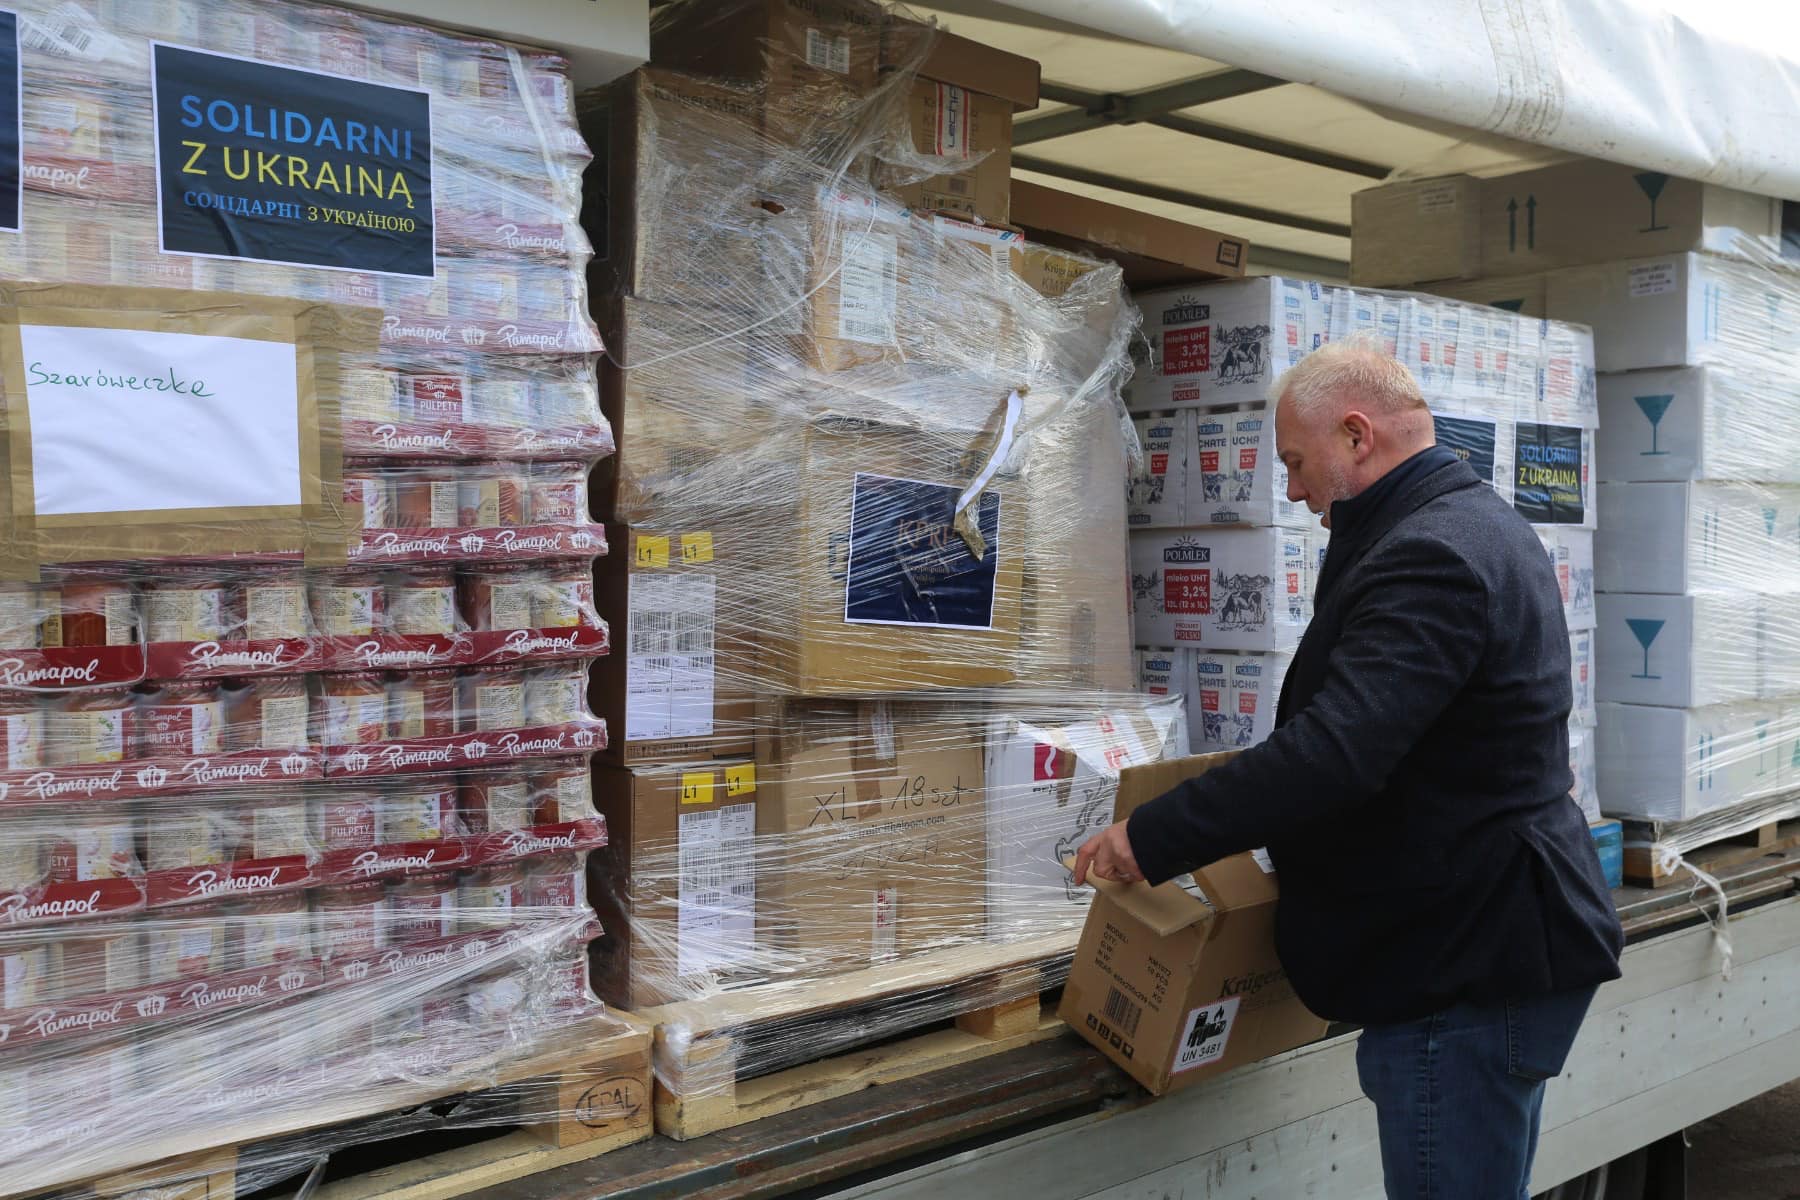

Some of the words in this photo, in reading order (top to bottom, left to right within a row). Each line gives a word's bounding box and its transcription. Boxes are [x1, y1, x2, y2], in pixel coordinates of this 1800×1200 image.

[180, 94, 412, 161] SOLIDARNI
[181, 140, 208, 176] Z
[223, 146, 415, 209] UKRAINĄ
[183, 190, 301, 220] СОЛІДАРНІ
[307, 206, 319, 222] З
[323, 207, 416, 233] УКРАЇНОЮ
[1165, 305, 1209, 324] POLMLEK
[381, 315, 451, 344] Pamapol
[497, 324, 563, 349] Pamapol
[1190, 331, 1207, 342] UHT
[1182, 344, 1207, 357] 3,2%
[420, 400, 459, 411] PULPETY
[372, 425, 453, 451] Pamapol
[1519, 444, 1578, 463] SOLIDARNI
[1519, 468, 1527, 485] Z
[1529, 468, 1579, 490] UKRAINĄ
[374, 532, 450, 556] Pamapol
[495, 529, 562, 552] Pamapol
[638, 547, 652, 561] L1
[684, 544, 697, 560] L1
[1165, 549, 1209, 561] POLMLEK
[1166, 574, 1190, 583] mleko
[1190, 574, 1208, 582] UHT
[1182, 586, 1208, 598] 3,2%
[505, 629, 579, 654] Pamapol
[1175, 630, 1201, 640] POLSKI
[191, 641, 285, 670] Pamapol
[354, 641, 437, 668] Pamapol
[0, 658, 99, 687] Pamapol
[380, 743, 453, 769] Pamapol
[498, 732, 565, 757] Pamapol
[183, 757, 269, 785] Pamapol
[24, 769, 122, 799] Pamapol
[684, 784, 697, 799] L1
[727, 776, 741, 792] L1
[809, 784, 857, 827] XL
[891, 775, 926, 810] 18
[331, 824, 370, 837] PULPETY
[503, 829, 577, 856] Pamapol
[352, 849, 435, 877] Pamapol
[187, 866, 281, 898] Pamapol
[0, 890, 101, 924] Pamapol
[380, 944, 453, 974] Pamapol
[180, 975, 267, 1009] Pamapol
[24, 1001, 122, 1037] Pamapol
[1182, 1050, 1198, 1063] UN
[1198, 1042, 1222, 1058] 3481
